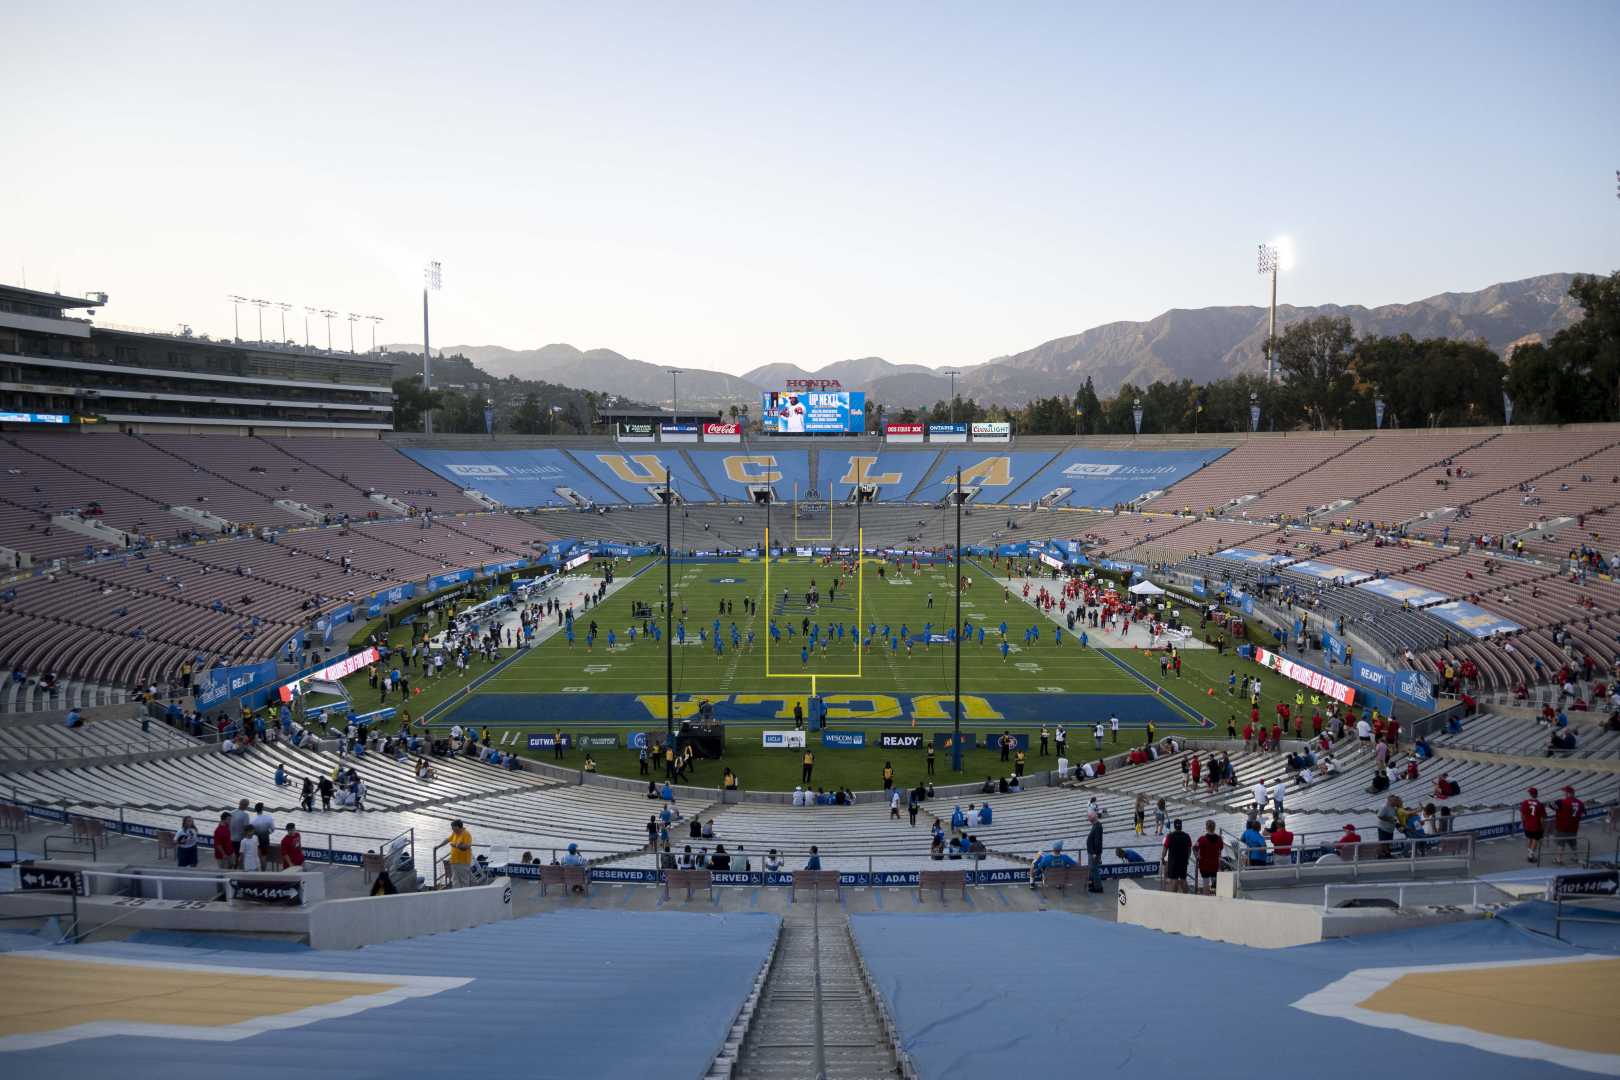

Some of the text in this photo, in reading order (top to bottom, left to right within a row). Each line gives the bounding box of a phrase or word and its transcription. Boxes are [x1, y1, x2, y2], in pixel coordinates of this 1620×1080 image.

[785, 380, 842, 388] HONDA
[809, 394, 819, 406] UP
[1360, 667, 1383, 684] READY
[232, 672, 255, 690] REY
[530, 738, 568, 746] CUTWAR
[883, 736, 918, 746] READY
[1529, 806, 1536, 816] 7
[1571, 806, 1578, 817] 7
[341, 854, 358, 863] ADA
[592, 869, 644, 879] RESERVED
[1111, 864, 1157, 875] RESERVED
[38, 873, 72, 889] 1-41
[711, 873, 749, 882] SERVED
[886, 876, 907, 884] ADA
[990, 872, 1010, 880] ADA
